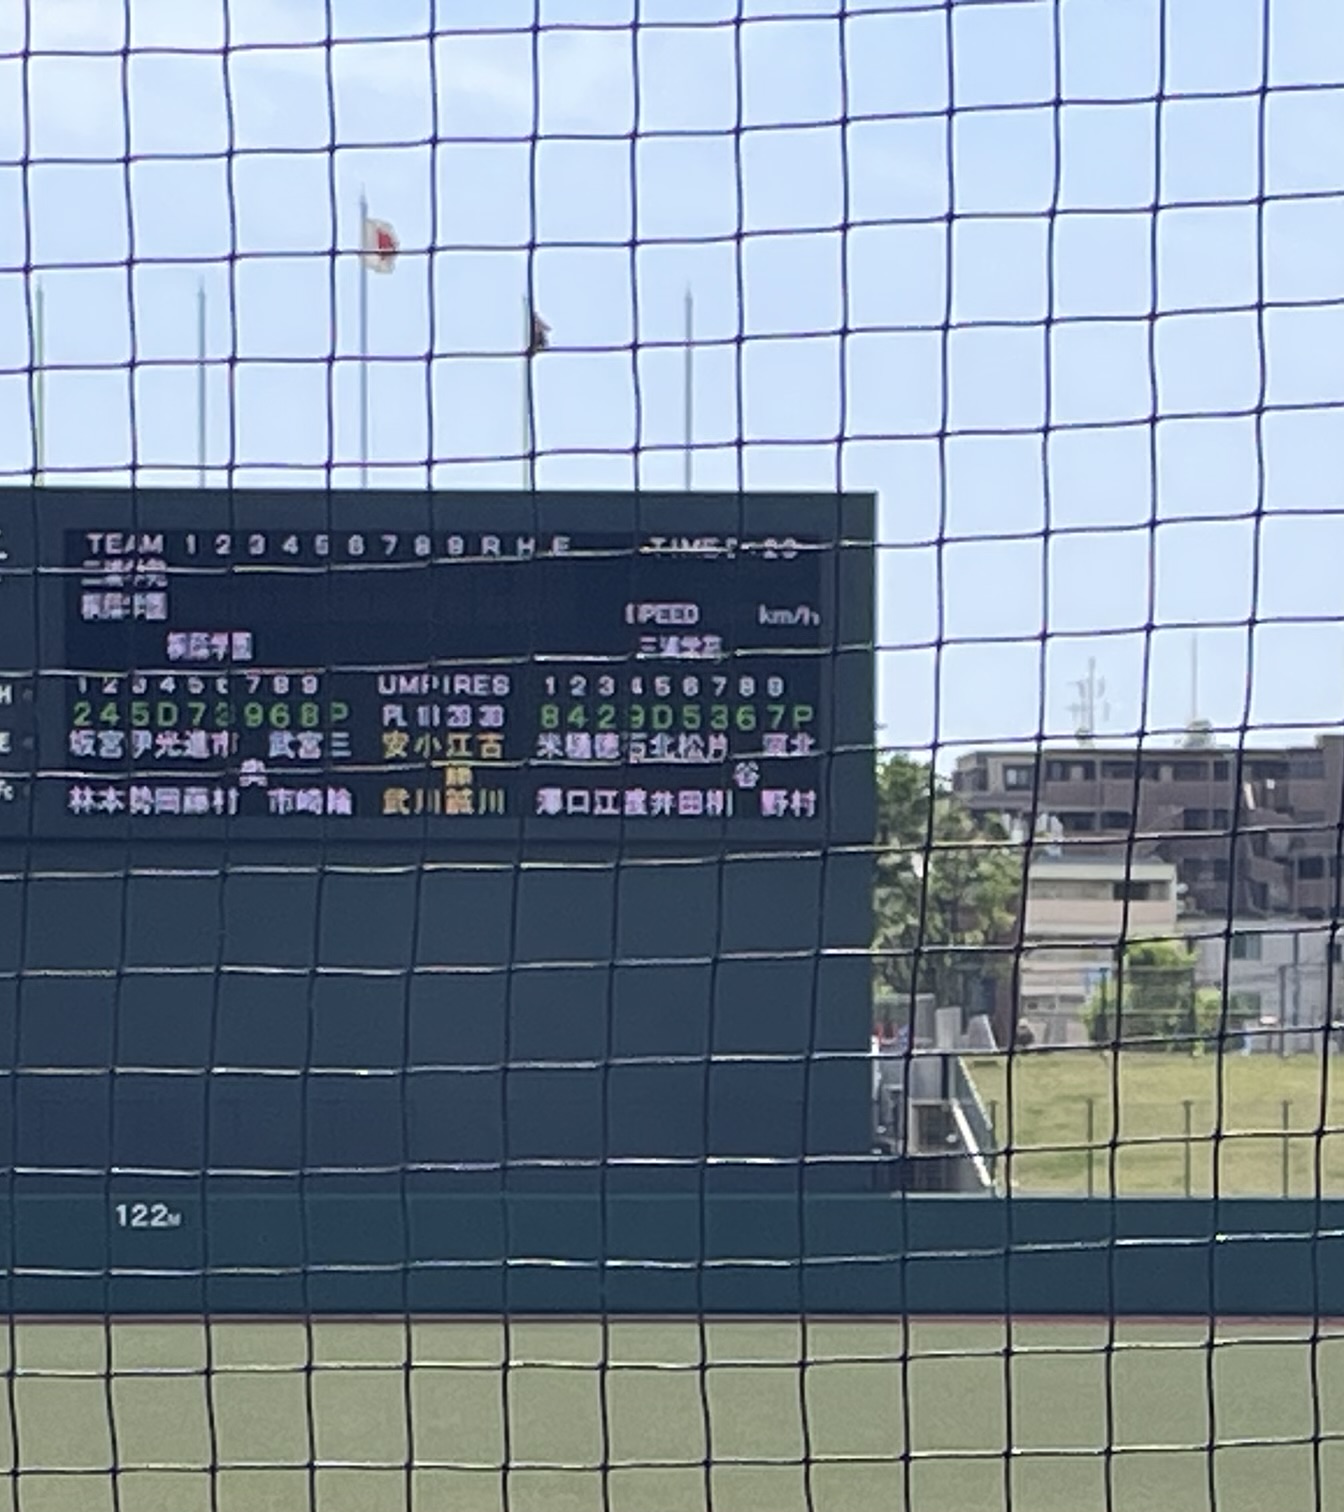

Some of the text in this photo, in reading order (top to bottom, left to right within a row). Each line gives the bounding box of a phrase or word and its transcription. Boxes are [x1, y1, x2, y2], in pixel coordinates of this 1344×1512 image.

[86, 534, 163, 554] TEAM
[186, 534, 195, 554] 1
[216, 534, 231, 554] 2
[249, 534, 265, 554] 3
[282, 535, 298, 554] 4
[315, 534, 328, 554] 5
[348, 535, 364, 554] 6
[381, 535, 397, 555] 7
[415, 535, 431, 555] 8
[448, 535, 464, 555] 9
[482, 536, 500, 556] R
[517, 537, 535, 557] H
[553, 537, 570, 556] E
[759, 604, 821, 626] km/h
[78, 675, 87, 694] 1
[103, 675, 118, 694] 2
[160, 675, 176, 694] 4
[246, 675, 261, 694] 7
[378, 674, 510, 695] UMPIRES
[545, 676, 555, 696] 1
[569, 676, 587, 696] 2
[599, 676, 615, 696] 3
[654, 676, 671, 696] 5
[683, 676, 699, 696] 6
[712, 676, 727, 696] 7
[739, 676, 755, 696] 8
[74, 702, 91, 727] 2
[100, 702, 120, 727] 4
[131, 702, 149, 727] 5
[188, 702, 206, 727] 7
[244, 702, 263, 727] 9
[270, 702, 290, 727] 6
[301, 702, 319, 727] 8
[330, 702, 349, 727] P
[541, 704, 560, 730] 8
[567, 704, 588, 730] 4
[598, 704, 616, 730] 2
[683, 704, 701, 730] 5
[711, 704, 728, 730] 3
[736, 704, 756, 730] 6
[767, 704, 785, 730] 7
[792, 704, 813, 730] P
